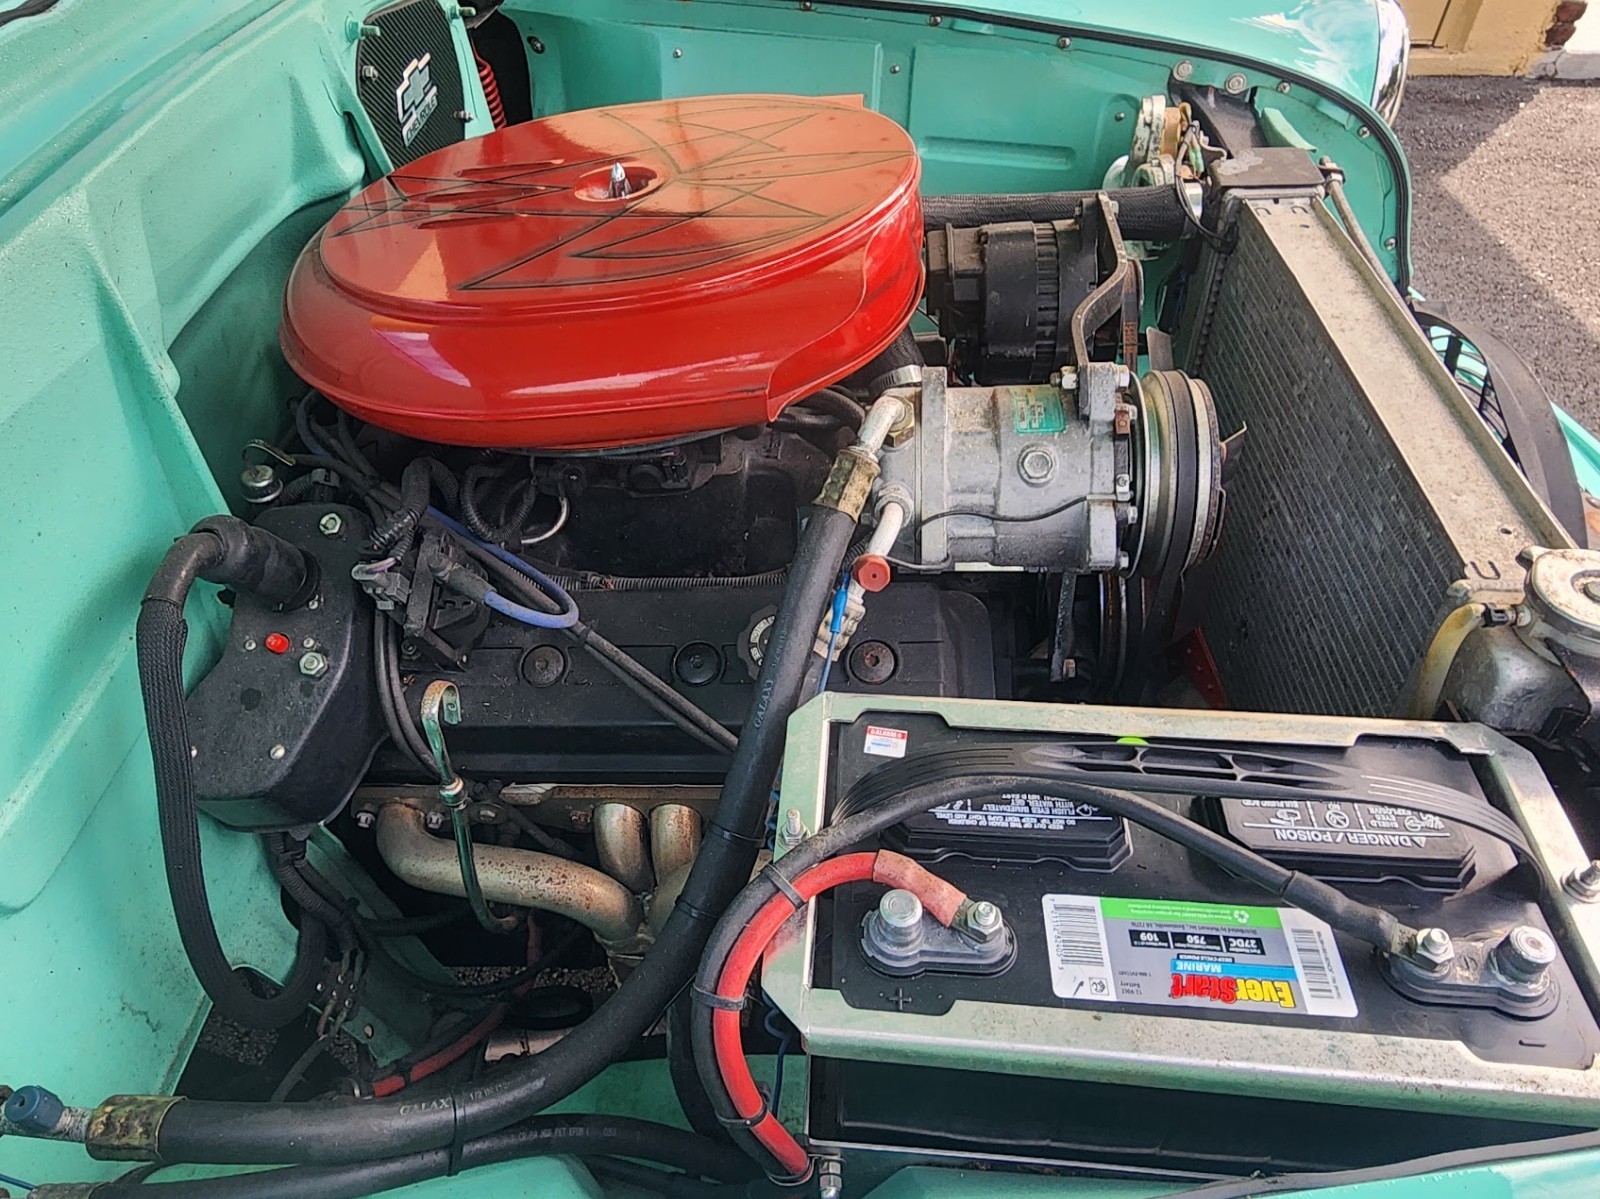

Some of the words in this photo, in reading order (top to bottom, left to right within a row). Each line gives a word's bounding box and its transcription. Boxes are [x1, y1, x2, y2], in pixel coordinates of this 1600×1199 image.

[754, 679, 774, 728] GALAXY
[1010, 798, 1026, 806] GET
[1055, 800, 1074, 808] WITH
[982, 804, 1029, 813] IMMEDIATELY
[1031, 806, 1050, 814] EYES
[1051, 807, 1075, 815] FLUSH
[1368, 806, 1412, 816] EXPLOSIVE
[935, 811, 954, 819] LEVEL
[968, 813, 986, 821] TIGHT
[1374, 813, 1396, 821] EYES
[947, 818, 978, 826] CHILDREN
[1369, 819, 1399, 828] SHIELD
[1274, 829, 1333, 843] POISON
[1346, 832, 1412, 846] DANGER
[1227, 928, 1257, 936] Distributed
[1139, 932, 1159, 942] 109
[1186, 934, 1207, 945] 750
[1228, 938, 1258, 948] 27DC
[1175, 960, 1222, 974] MARINE
[1120, 980, 1140, 989] Battery
[1171, 973, 1296, 1009] EverStart
